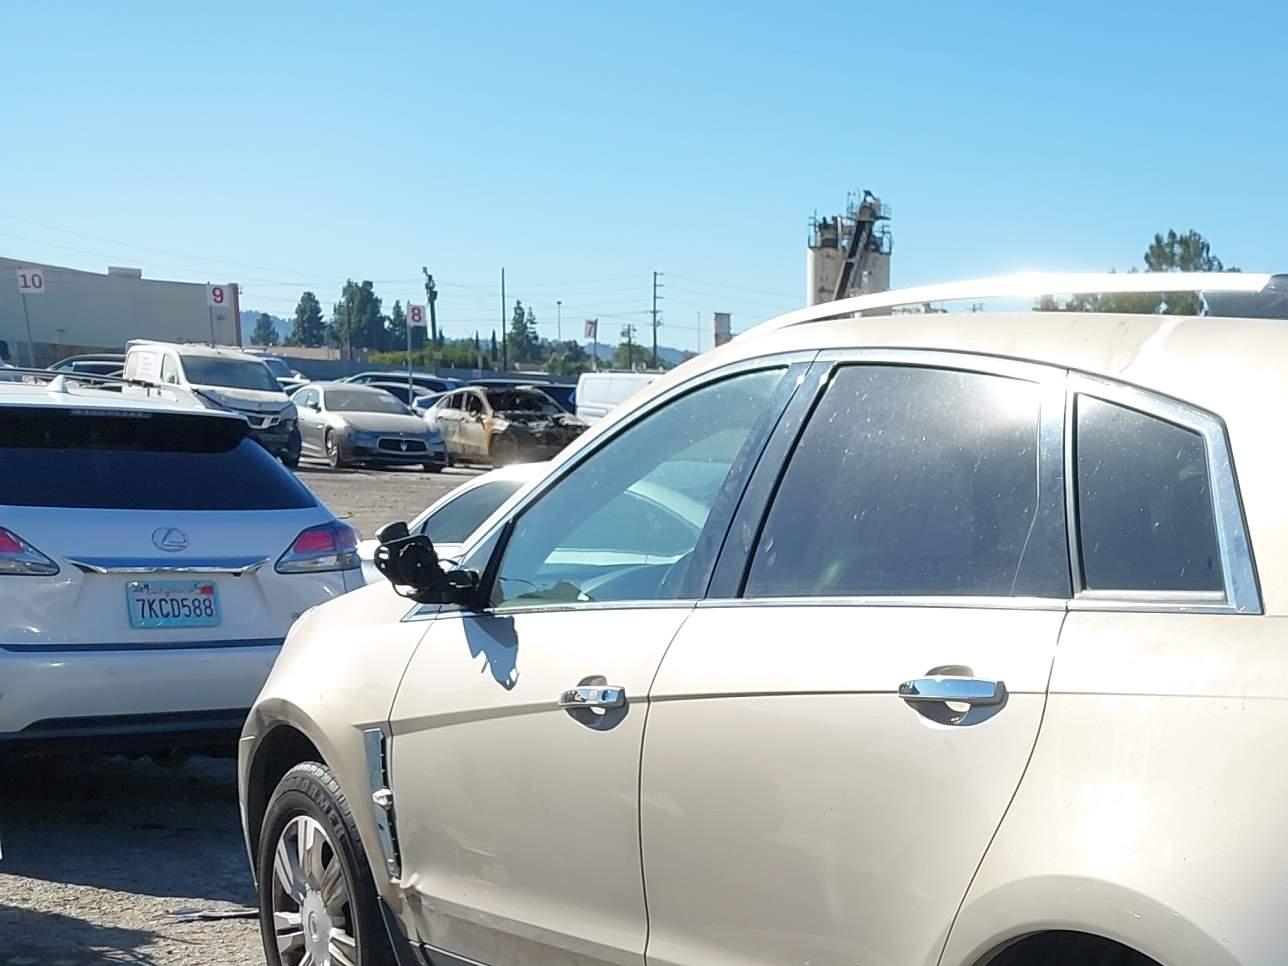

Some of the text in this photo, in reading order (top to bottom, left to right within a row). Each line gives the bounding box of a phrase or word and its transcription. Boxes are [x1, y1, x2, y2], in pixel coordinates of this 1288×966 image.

[19, 273, 43, 289] 10
[212, 287, 224, 304] 9
[410, 306, 423, 323] 8
[135, 598, 214, 619] 7KCD588
